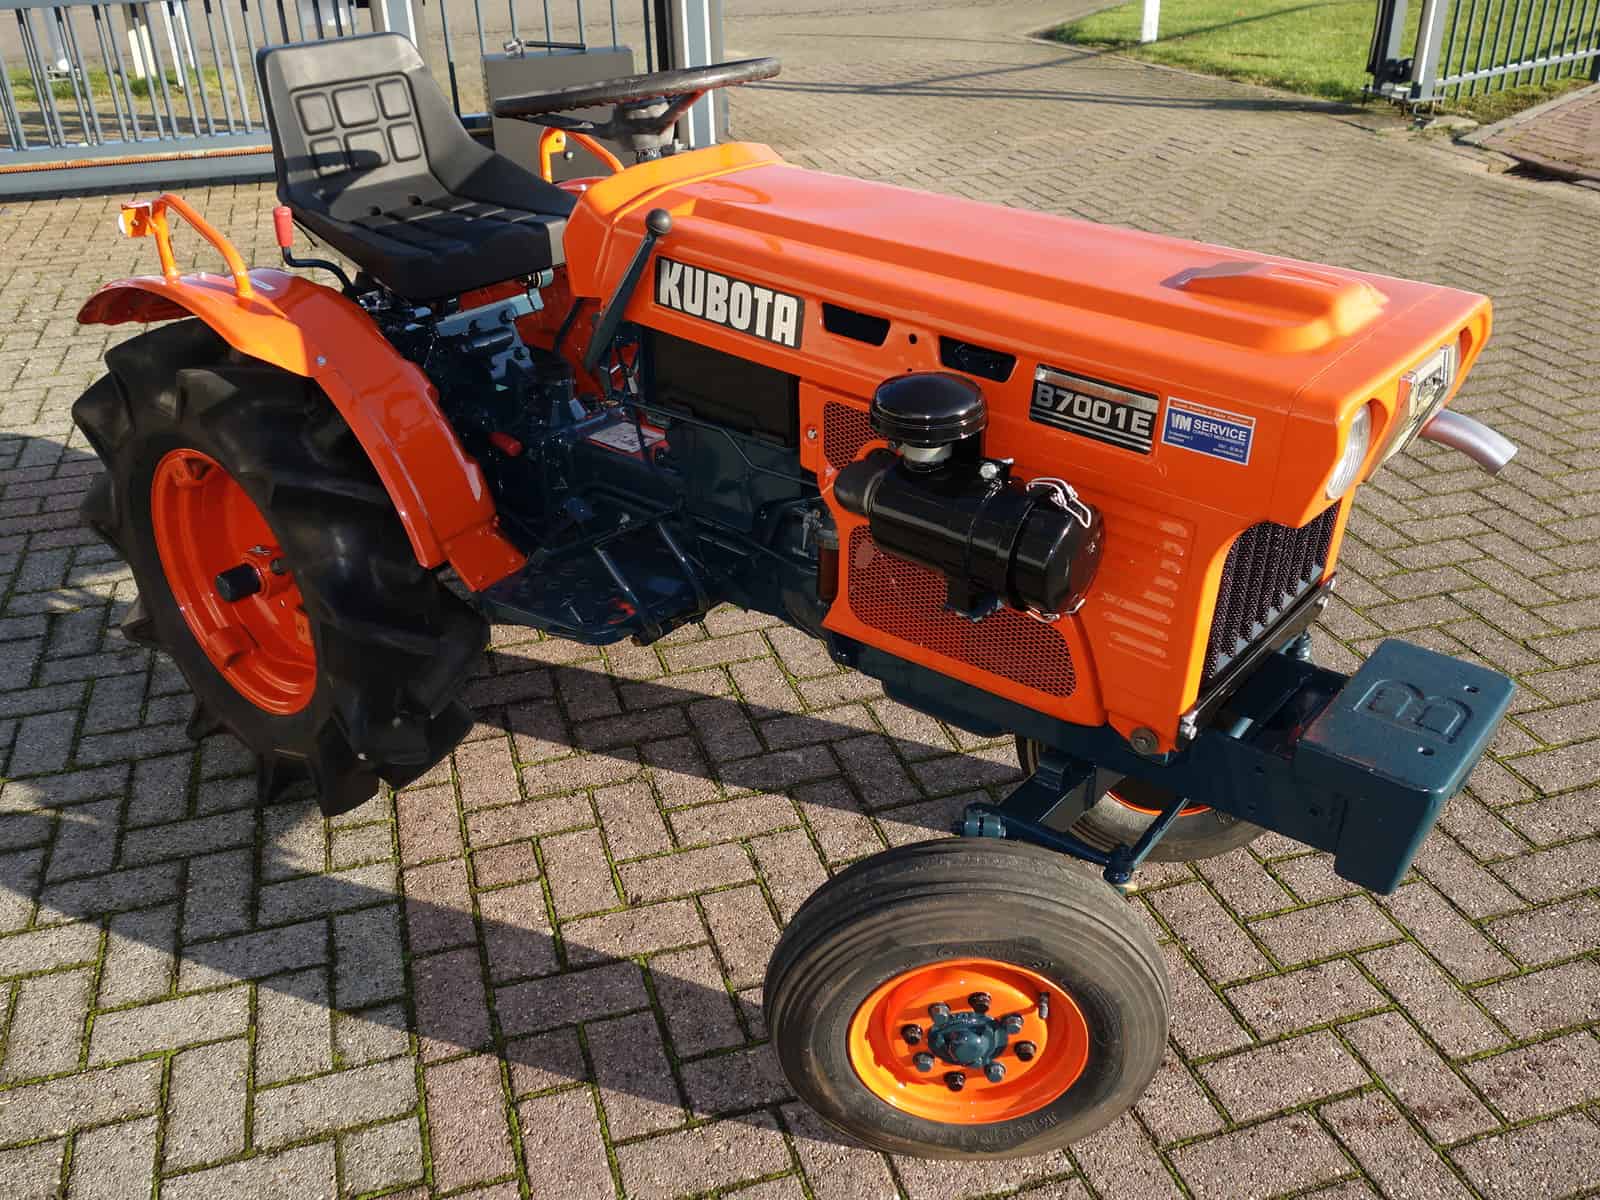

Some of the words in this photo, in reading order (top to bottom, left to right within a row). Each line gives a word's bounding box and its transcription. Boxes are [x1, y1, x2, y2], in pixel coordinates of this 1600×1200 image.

[659, 259, 798, 347] KUBOTA
[1035, 383, 1152, 437] B7001E
[1193, 418, 1248, 442] SERVICE
[1350, 678, 1473, 744] B
